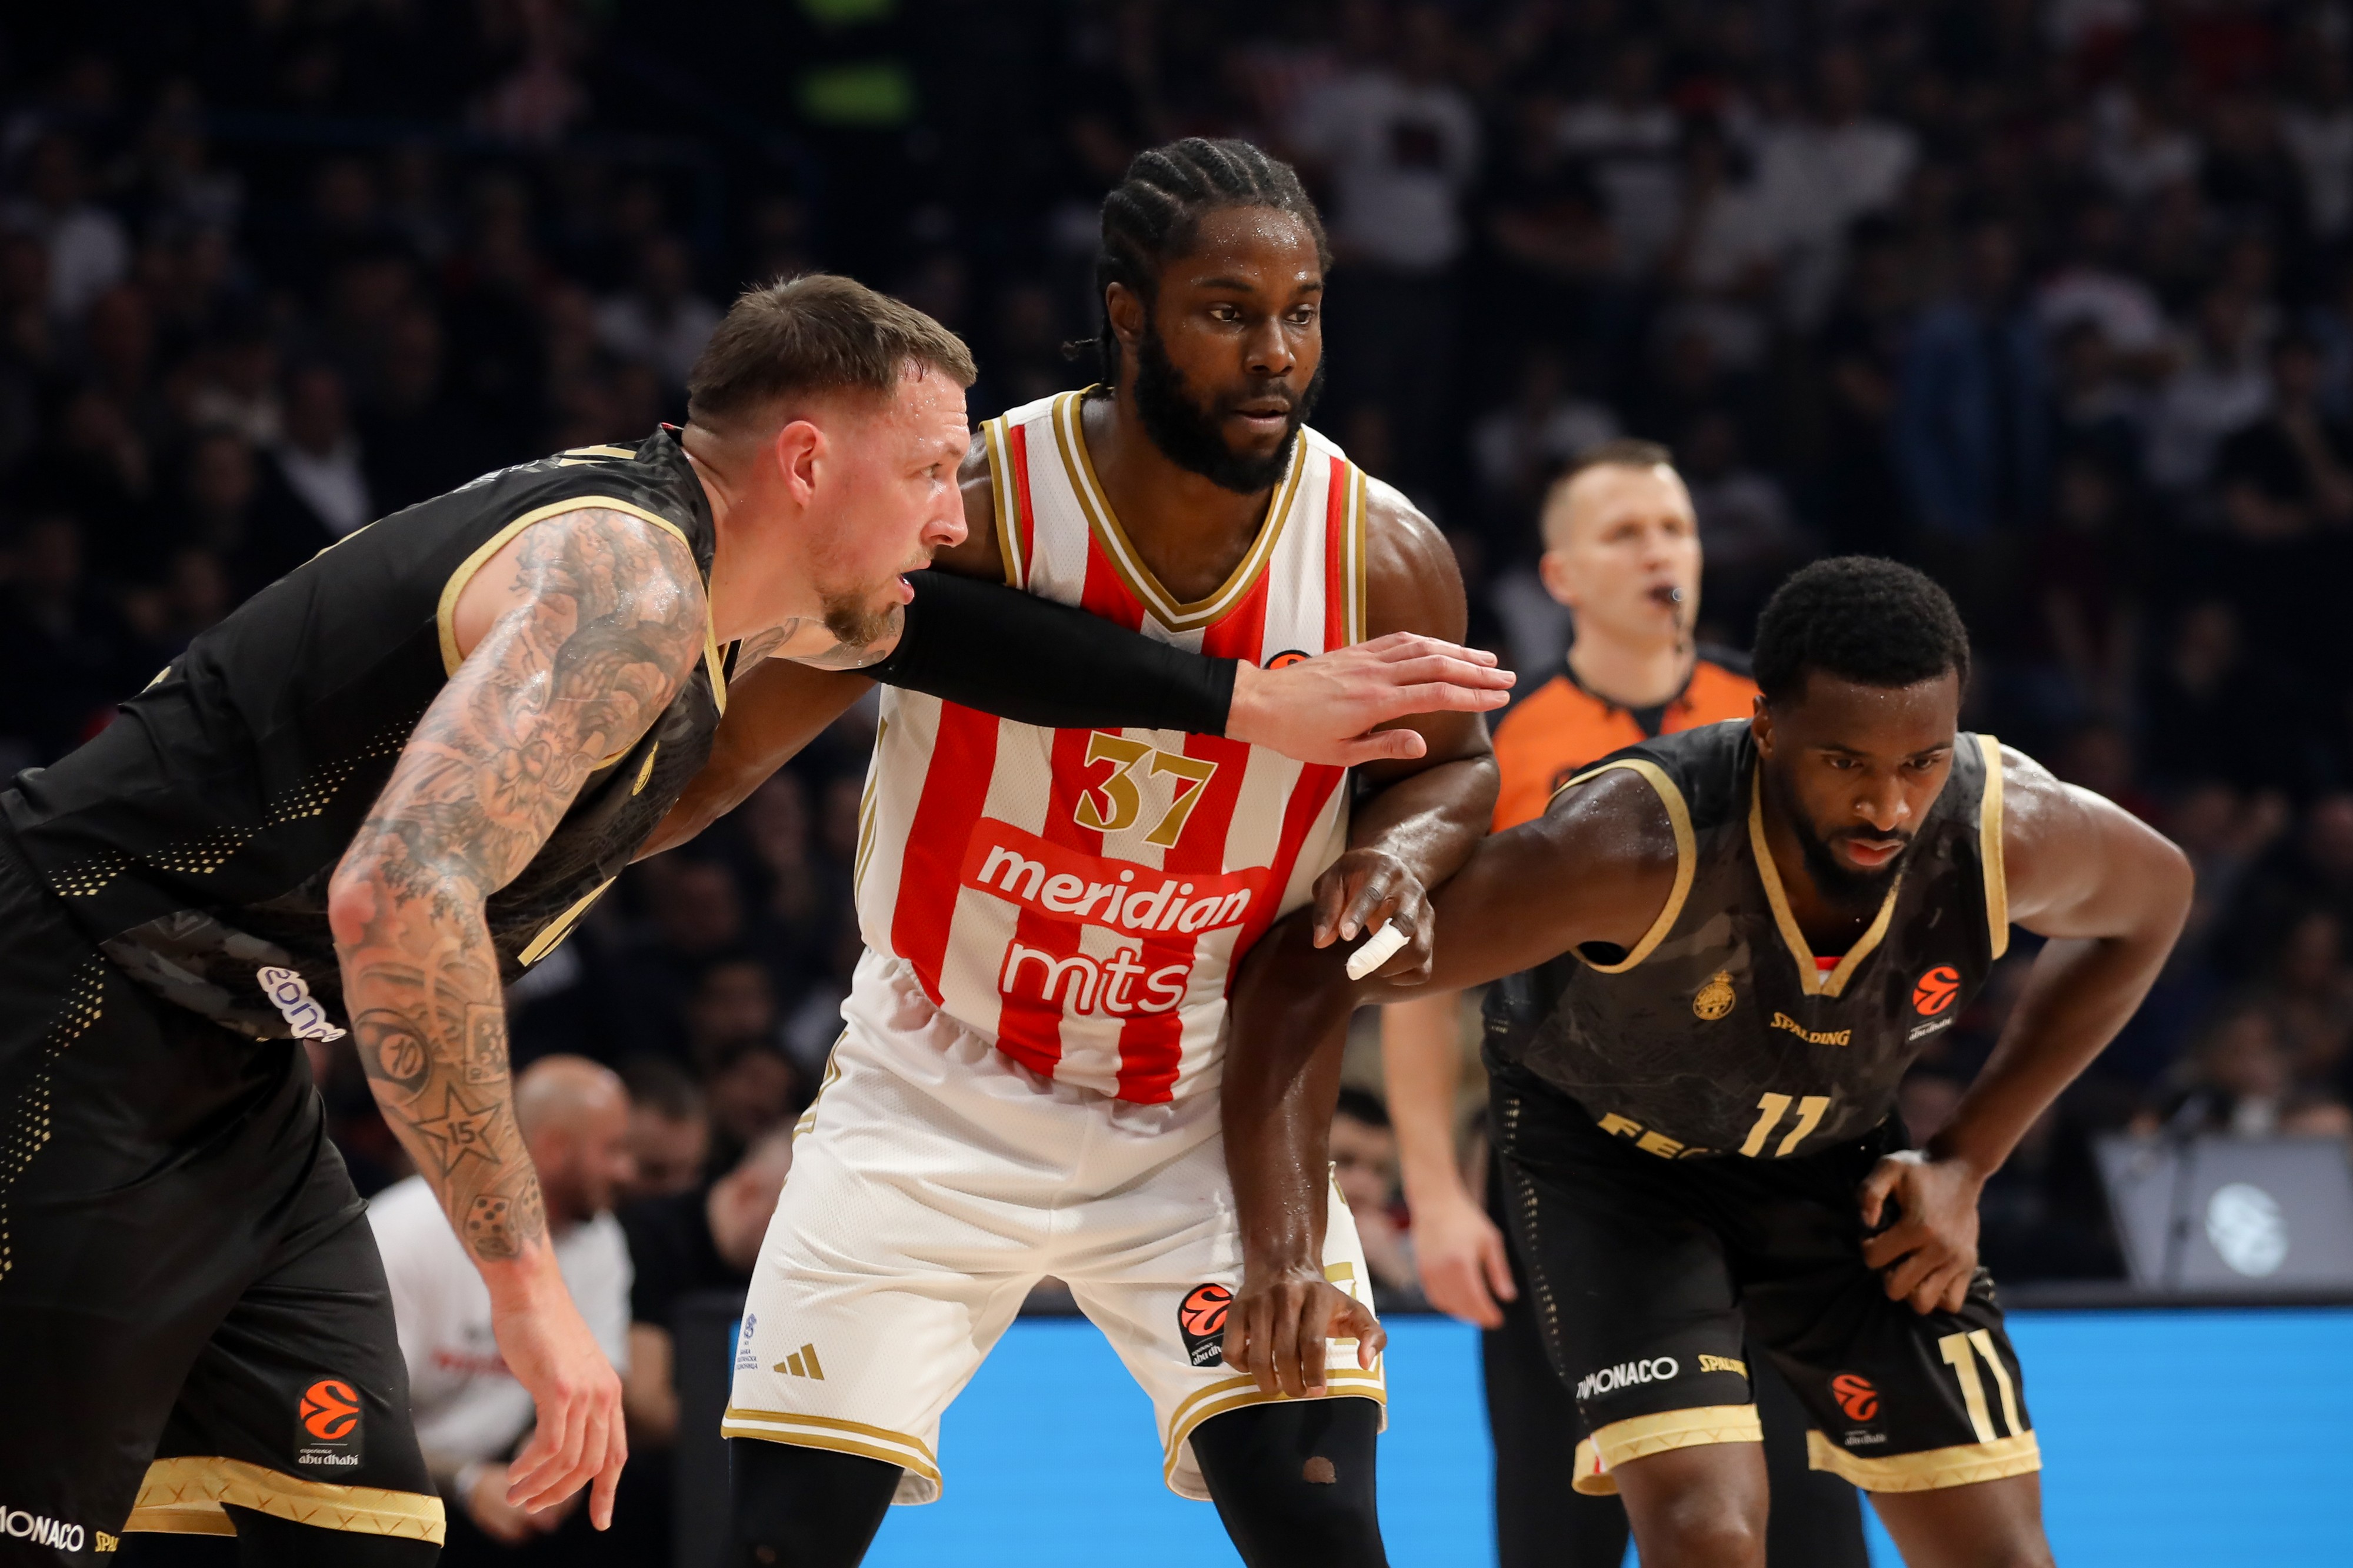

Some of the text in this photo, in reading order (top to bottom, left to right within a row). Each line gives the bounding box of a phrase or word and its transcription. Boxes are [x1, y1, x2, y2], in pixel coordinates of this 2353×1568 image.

[1074, 731, 1219, 849] 37
[976, 845, 1252, 933] meridian
[1002, 943, 1189, 1012] mts
[1770, 1012, 1852, 1046] SPALDING
[447, 1120, 476, 1146] 15
[1597, 1112, 1709, 1159] FE
[1738, 1092, 1831, 1158] 11
[1208, 1345, 1222, 1357] dh
[1938, 1327, 2024, 1444] 11
[298, 1454, 359, 1465] abu dhabi
